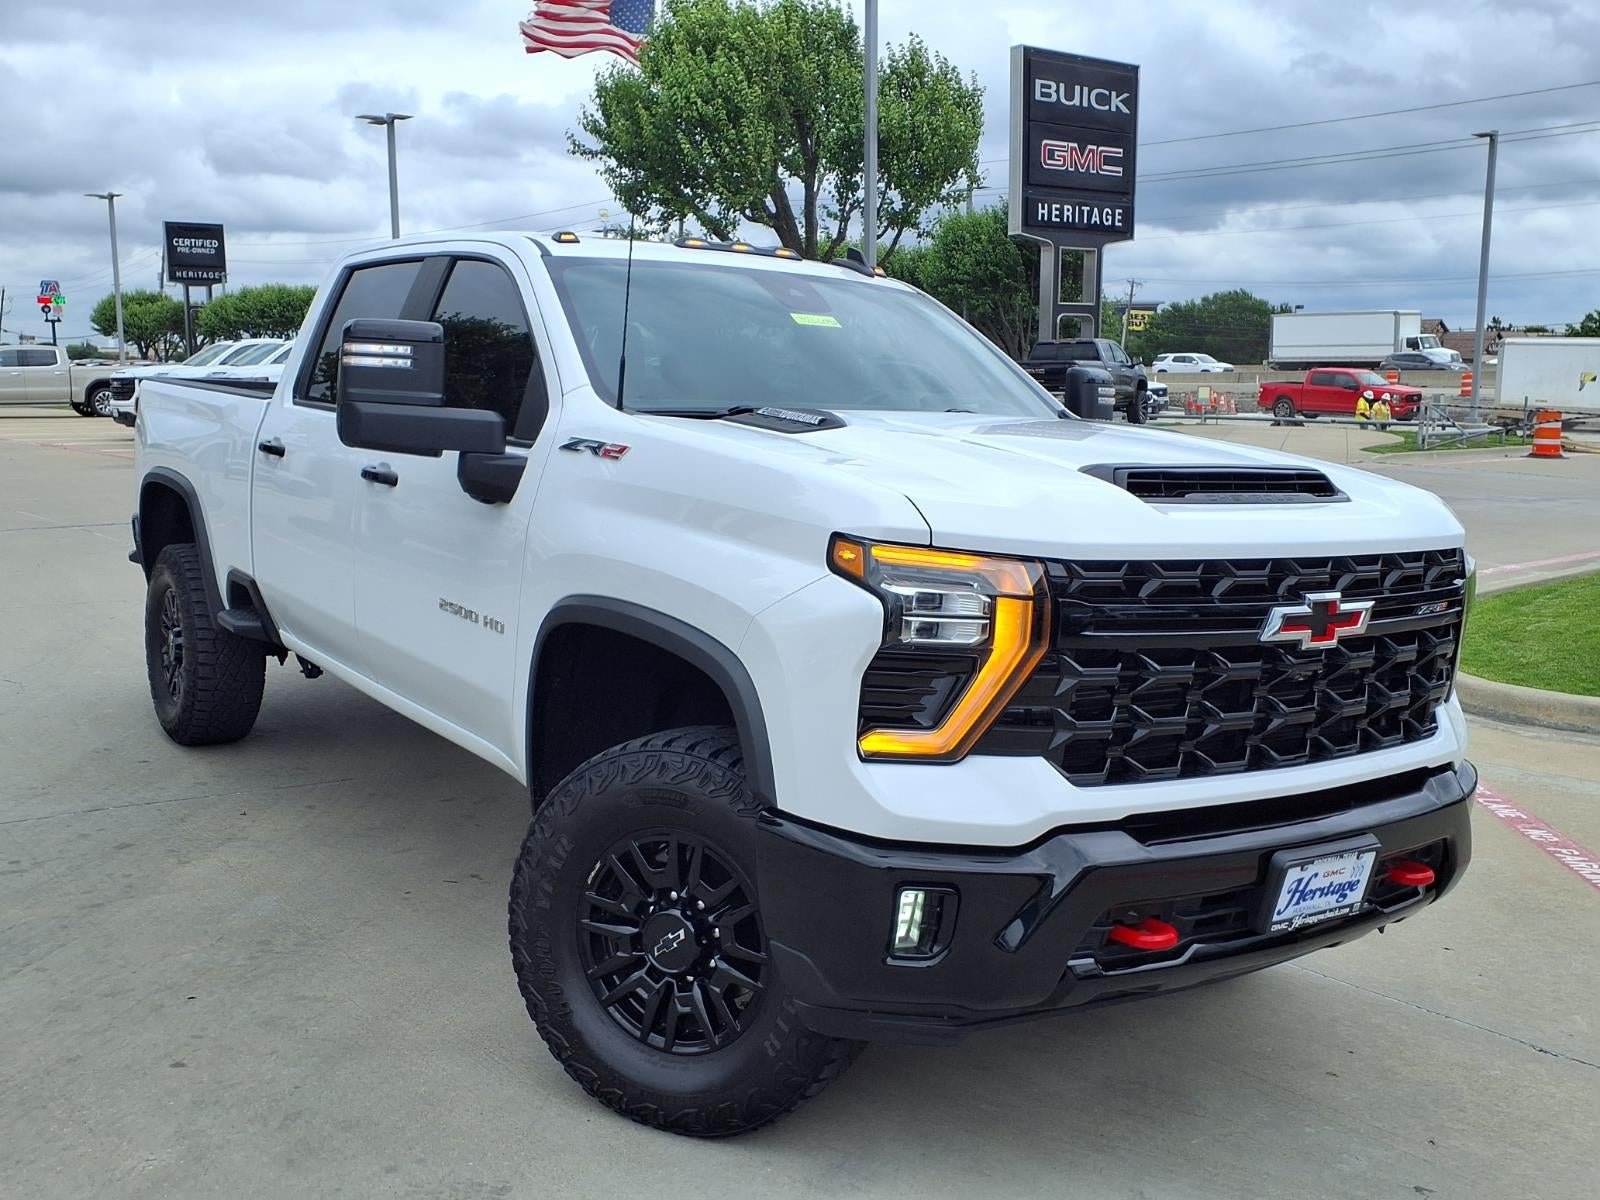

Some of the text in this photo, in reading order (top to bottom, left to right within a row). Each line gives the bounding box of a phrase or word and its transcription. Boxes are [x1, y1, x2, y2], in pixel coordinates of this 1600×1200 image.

[1034, 78, 1131, 115] BUICK
[1041, 139, 1124, 177] GMC
[1038, 202, 1124, 227] HERITAGE
[172, 237, 219, 248] CERTIFIED
[176, 246, 216, 255] PRE-OWNED
[175, 270, 221, 279] HERITAGE
[558, 436, 632, 461] ZR2
[439, 598, 480, 624] 2500
[483, 614, 505, 634] HD
[1322, 867, 1347, 879] GMC
[1276, 872, 1361, 916] Heritage
